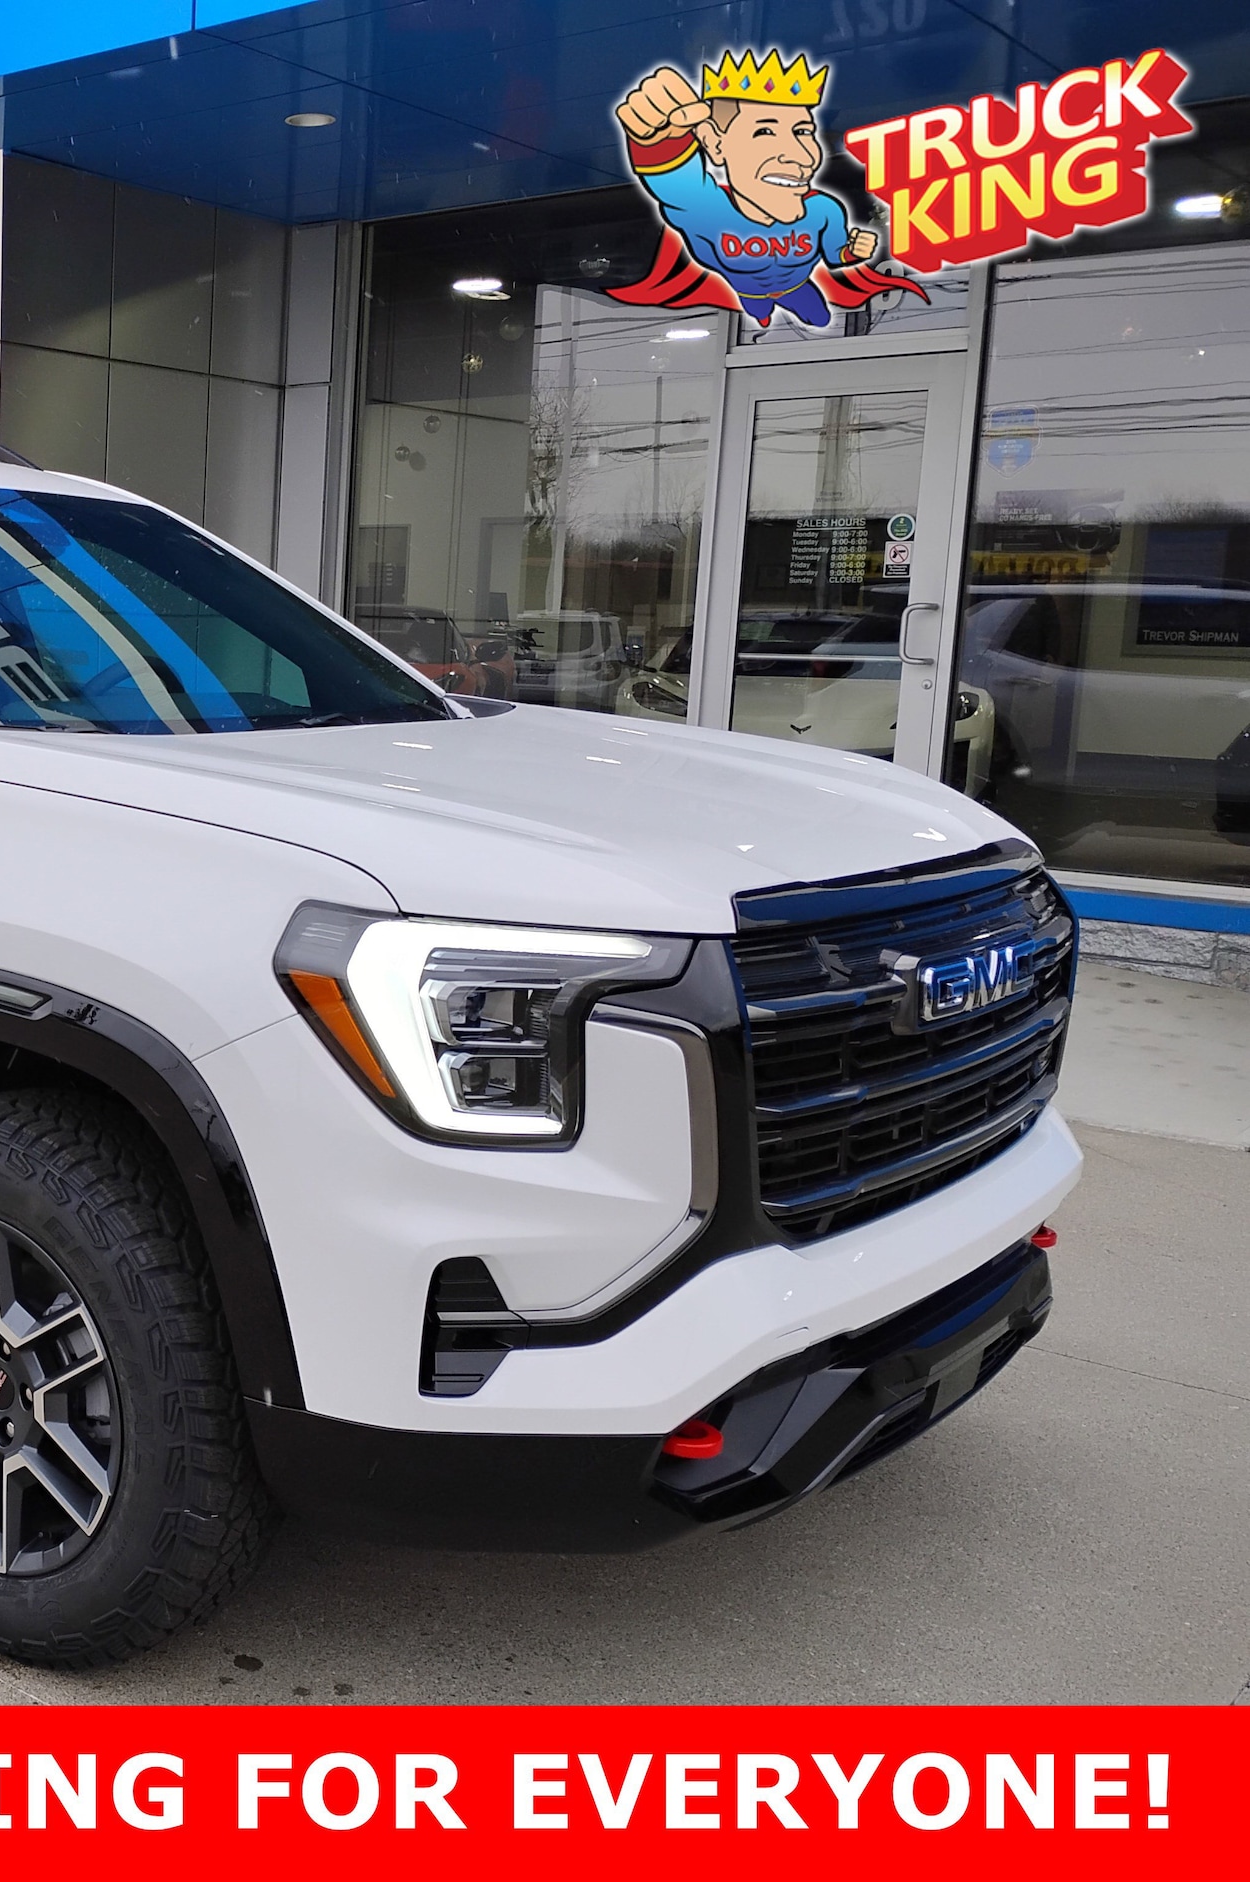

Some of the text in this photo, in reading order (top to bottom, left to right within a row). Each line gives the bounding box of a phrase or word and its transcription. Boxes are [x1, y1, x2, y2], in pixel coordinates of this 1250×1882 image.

[796, 518, 866, 528] SALES HOURS
[793, 530, 819, 538] Monday
[793, 538, 819, 546] Tuesday
[792, 545, 830, 554] Wednesday
[791, 553, 821, 562] Thursday
[790, 561, 811, 569] Friday
[1142, 629, 1239, 642] TREVOR SHIPMAN
[921, 938, 1036, 1023] GMC
[41, 1215, 155, 1475] GENERAL
